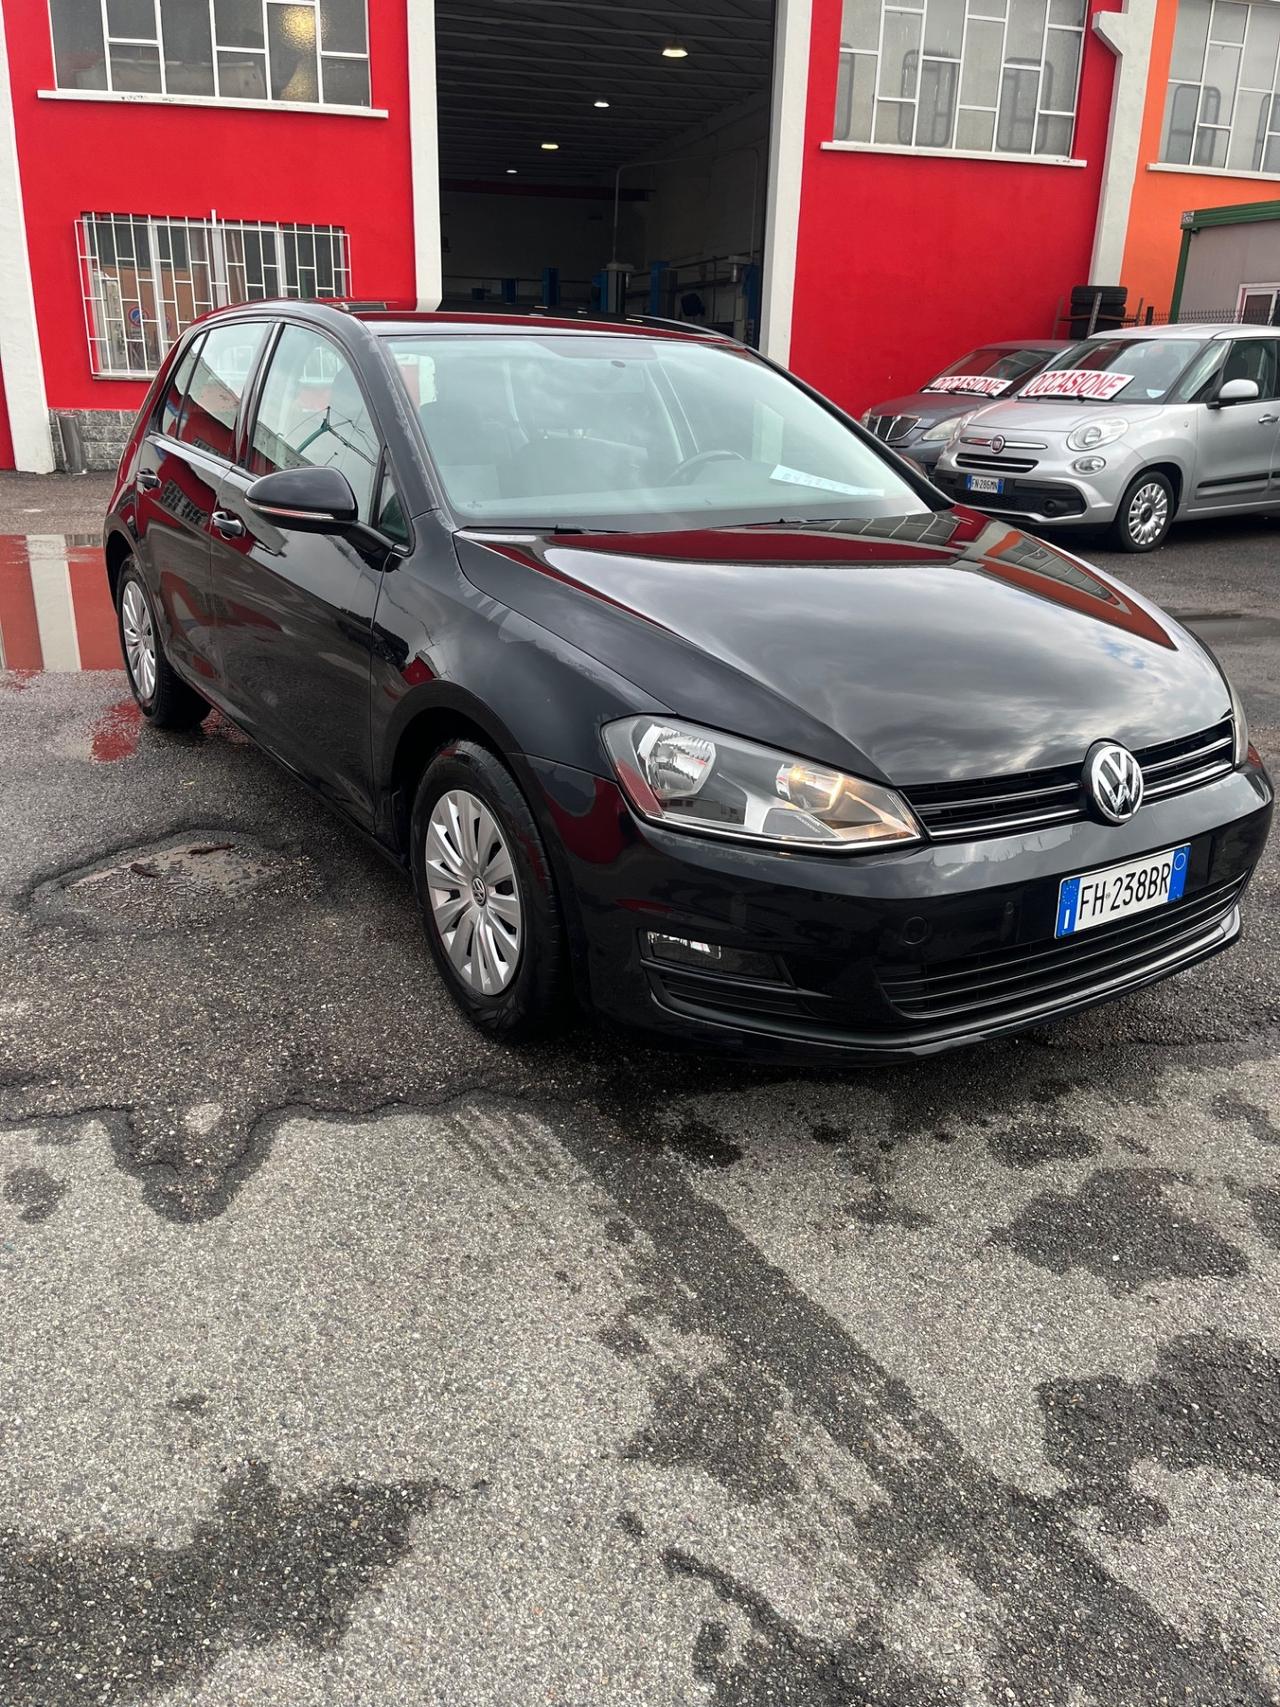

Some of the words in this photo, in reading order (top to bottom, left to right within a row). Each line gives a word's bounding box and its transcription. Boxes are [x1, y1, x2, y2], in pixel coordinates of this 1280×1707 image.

[932, 377, 1005, 394] OCCASIONE
[1024, 372, 1126, 397] OCCASIONE
[1078, 880, 1107, 920] FH
[1110, 863, 1171, 911] 238BR
